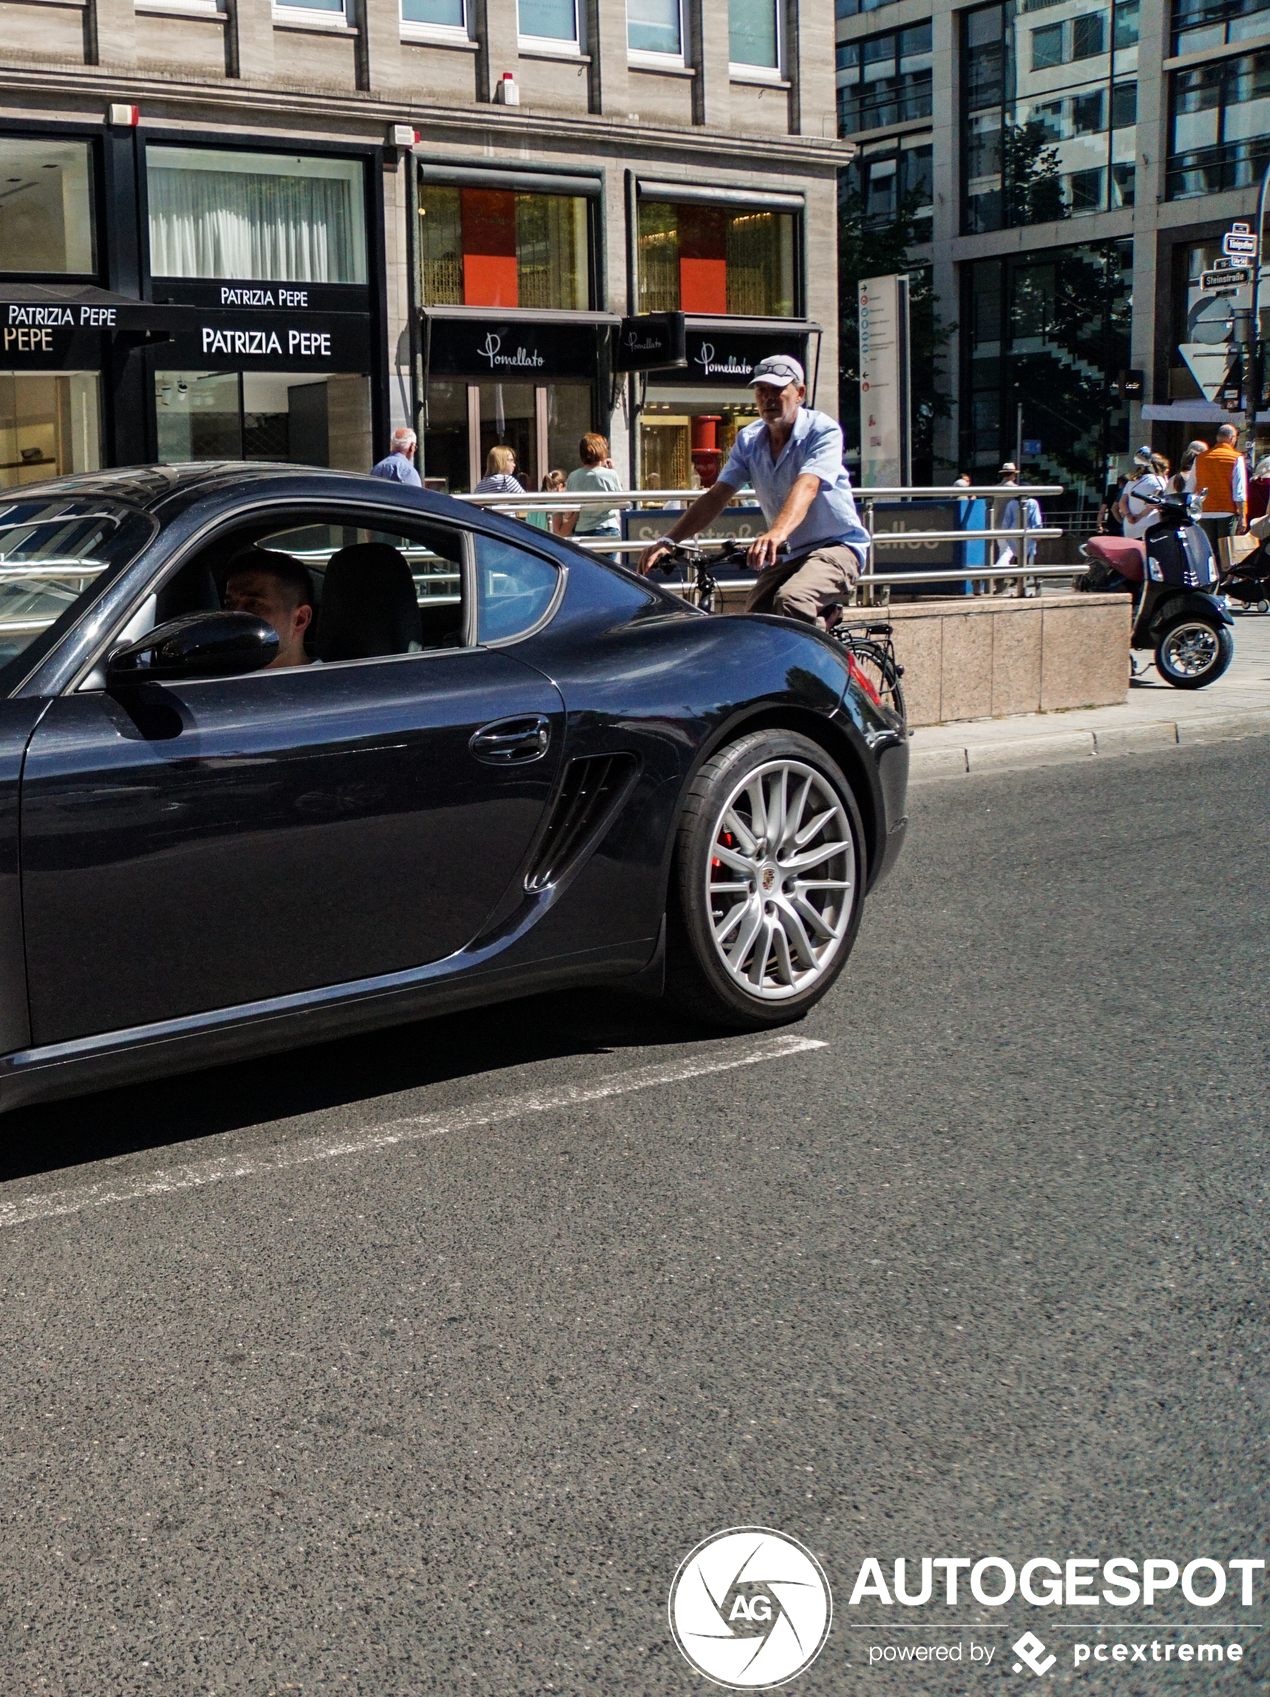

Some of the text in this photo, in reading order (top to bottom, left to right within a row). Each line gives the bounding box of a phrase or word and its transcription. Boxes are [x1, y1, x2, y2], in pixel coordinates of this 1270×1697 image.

[221, 287, 308, 307] PATRIZIA PEPE
[8, 305, 117, 326] PATRIZIA PEPE
[4, 327, 54, 351] PEPE
[202, 327, 332, 355] PATRIZIA PEPE
[476, 332, 545, 368] Pomellato
[624, 332, 662, 352] Pomellato
[694, 341, 753, 375] Pomellato
